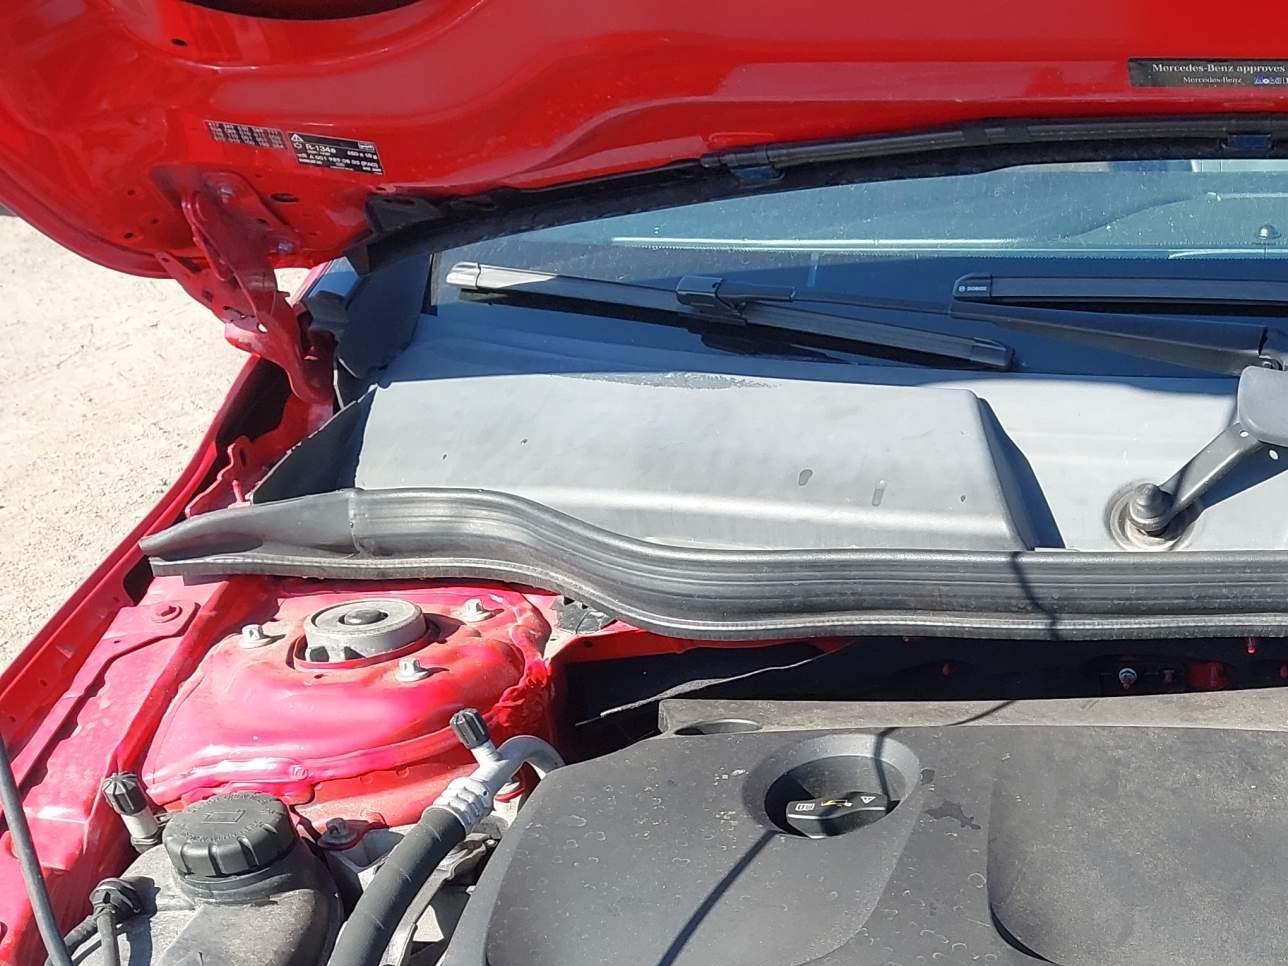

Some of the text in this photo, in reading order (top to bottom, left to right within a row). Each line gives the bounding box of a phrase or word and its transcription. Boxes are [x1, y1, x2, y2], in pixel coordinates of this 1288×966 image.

[1152, 63, 1234, 72] Mercedes-Benz
[1236, 65, 1286, 75] approves
[1183, 75, 1242, 84] Mercedes-Benz
